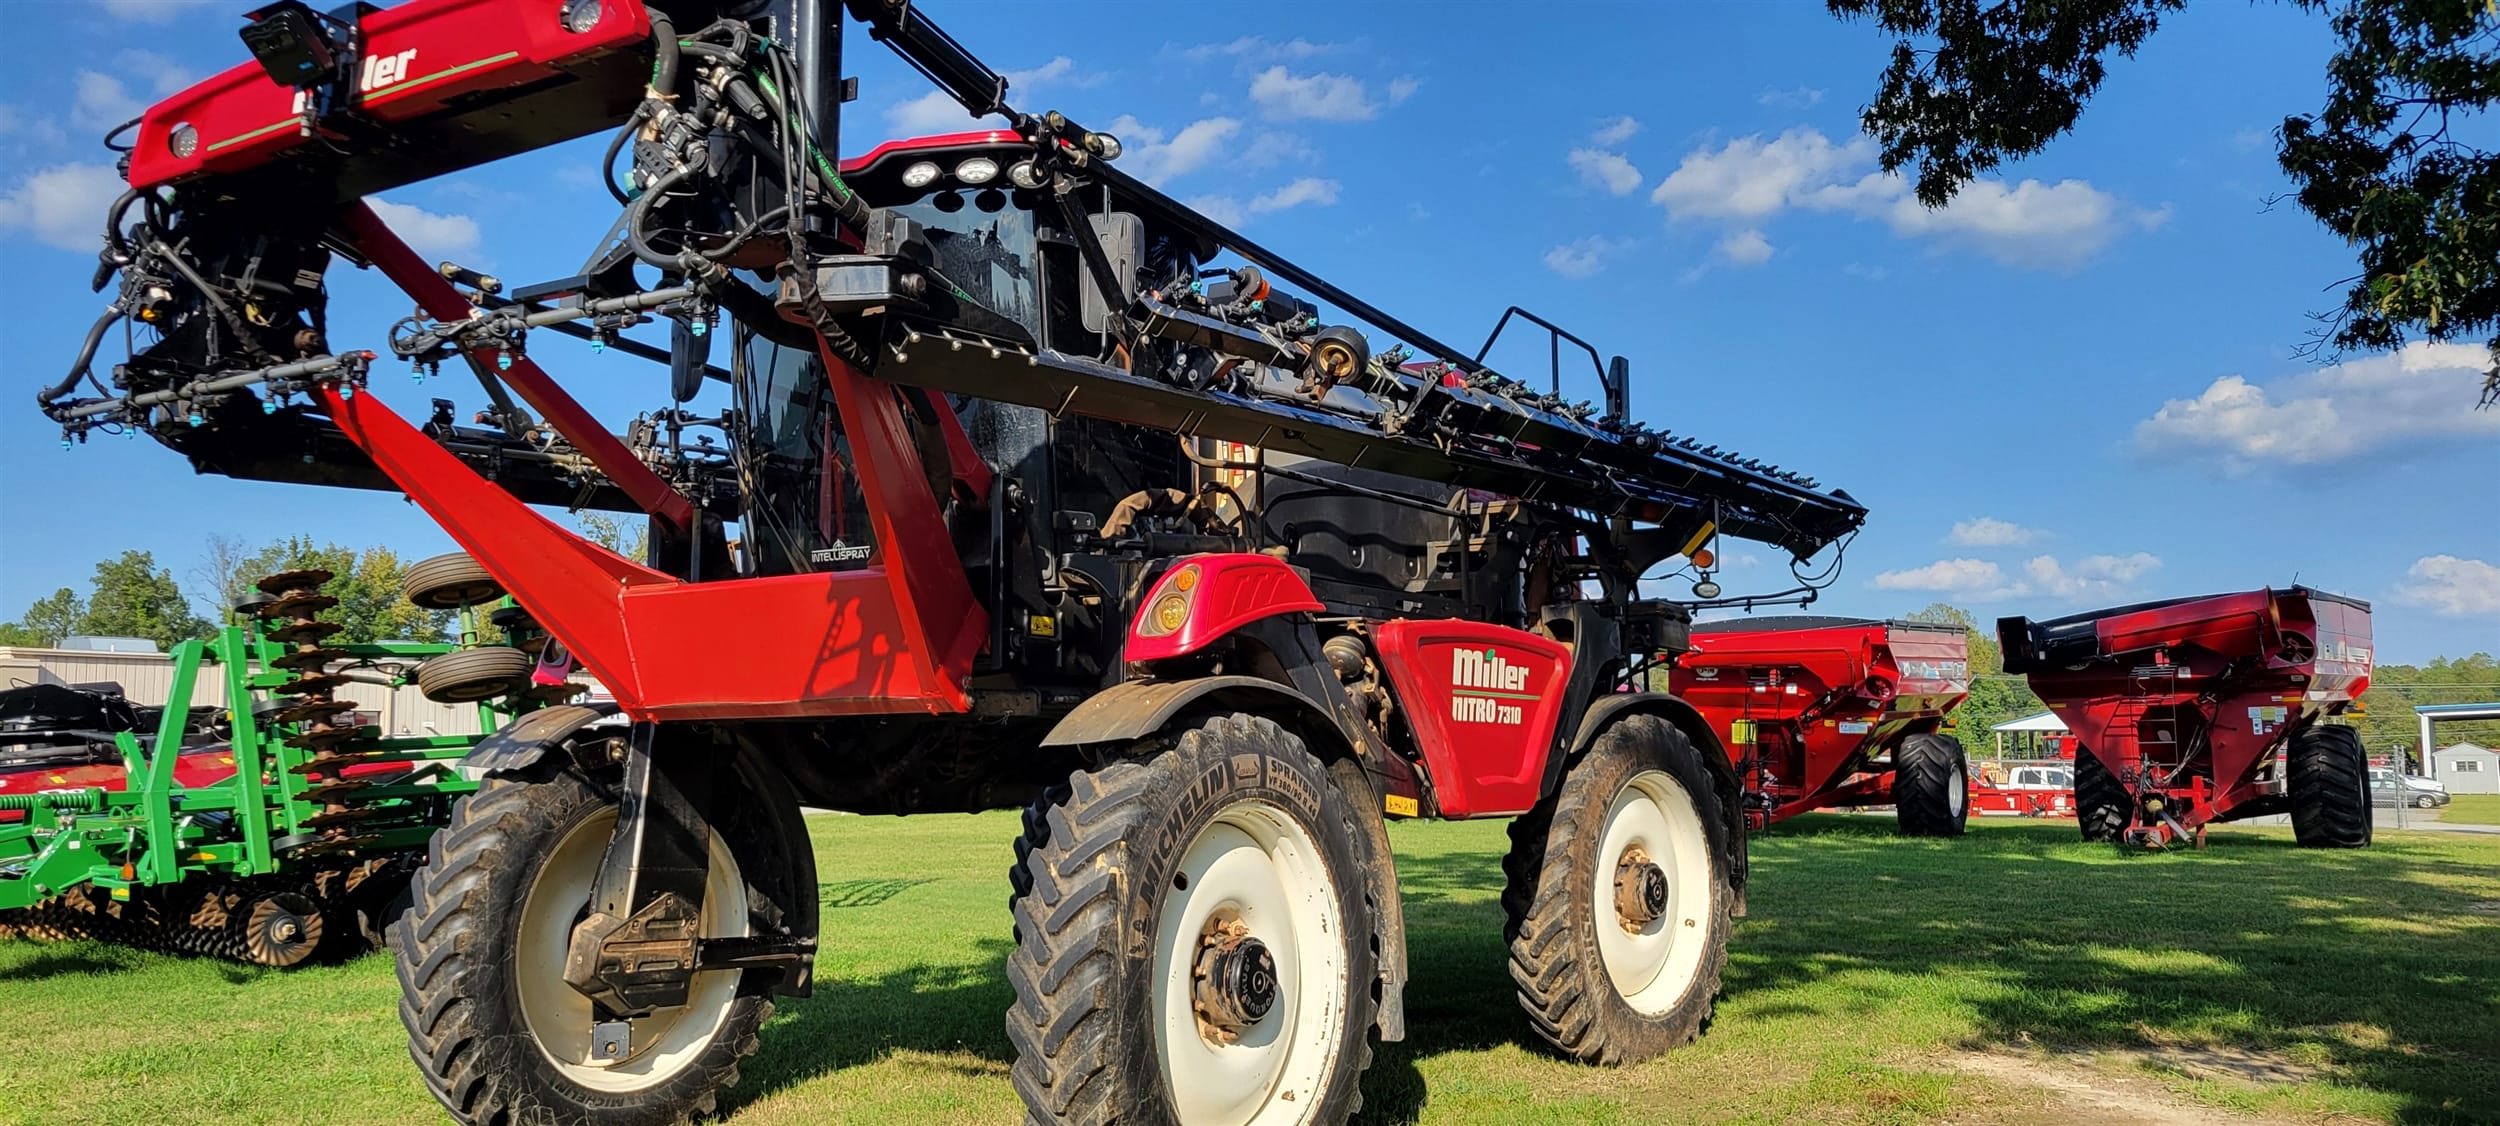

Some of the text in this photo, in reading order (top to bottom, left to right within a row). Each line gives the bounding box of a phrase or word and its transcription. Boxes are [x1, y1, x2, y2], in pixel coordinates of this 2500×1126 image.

[811, 549, 871, 563] INTELLISPRAY
[1452, 647, 1529, 691] Miller
[1452, 696, 1522, 725] NITRO 7310
[1271, 759, 1318, 803] SPRAYBIB
[1139, 764, 1226, 909] MICHELIN
[1245, 992, 1274, 1014] TORQUE
[554, 1079, 625, 1108] MICHELIN
